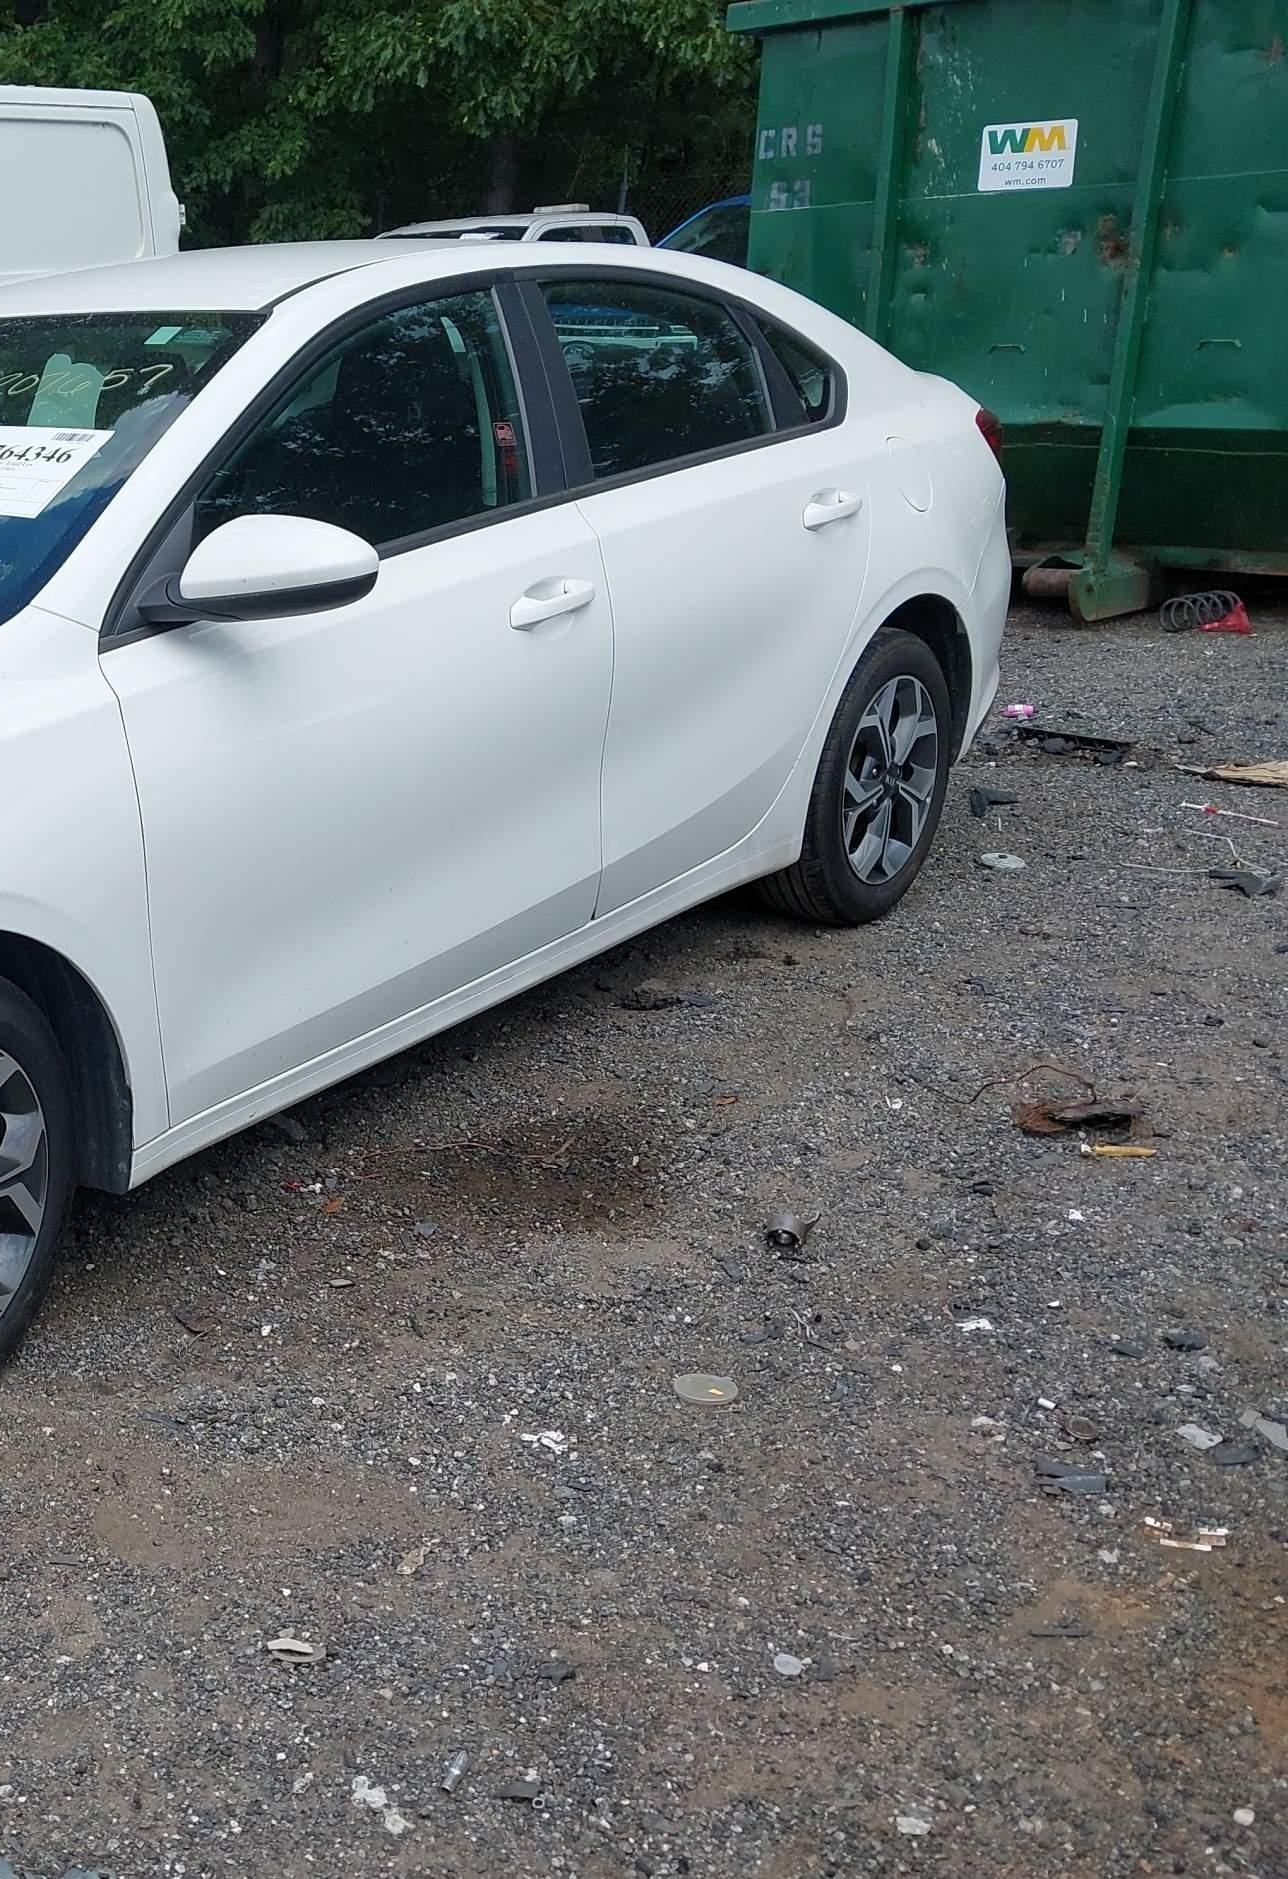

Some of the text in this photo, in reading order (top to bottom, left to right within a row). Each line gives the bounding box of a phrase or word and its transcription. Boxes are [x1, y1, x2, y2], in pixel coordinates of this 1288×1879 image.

[988, 126, 1066, 155] WM
[992, 159, 1064, 172] 404 794 6707
[1005, 177, 1046, 186] wm.com
